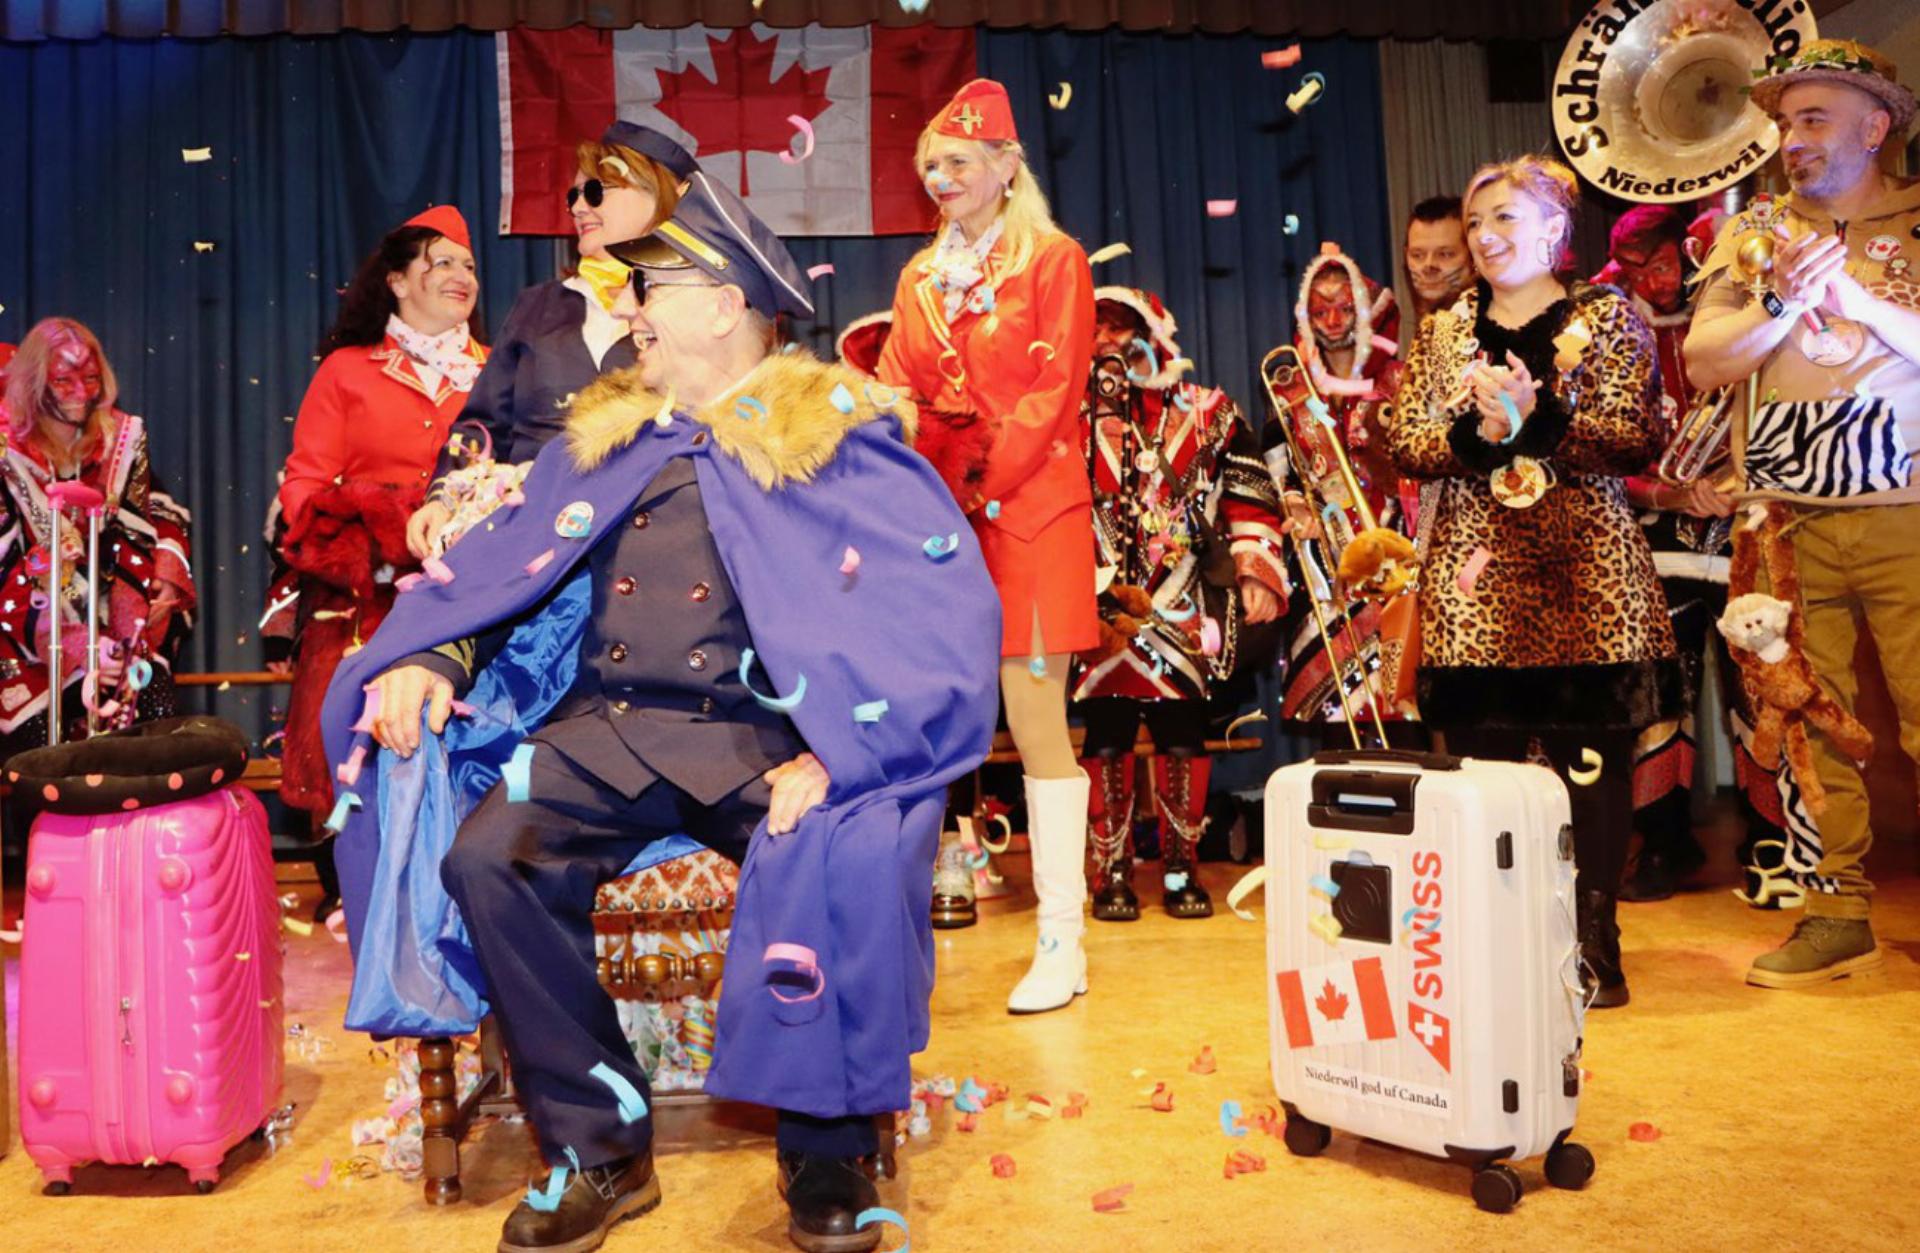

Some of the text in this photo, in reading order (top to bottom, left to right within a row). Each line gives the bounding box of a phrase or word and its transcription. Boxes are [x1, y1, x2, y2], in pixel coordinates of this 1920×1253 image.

[1557, 0, 1656, 158] Schrän
[1598, 141, 1766, 195] Niederwil
[1412, 851, 1443, 1000] SWISS
[1305, 1066, 1448, 1109] Niederwil god uf Canada
